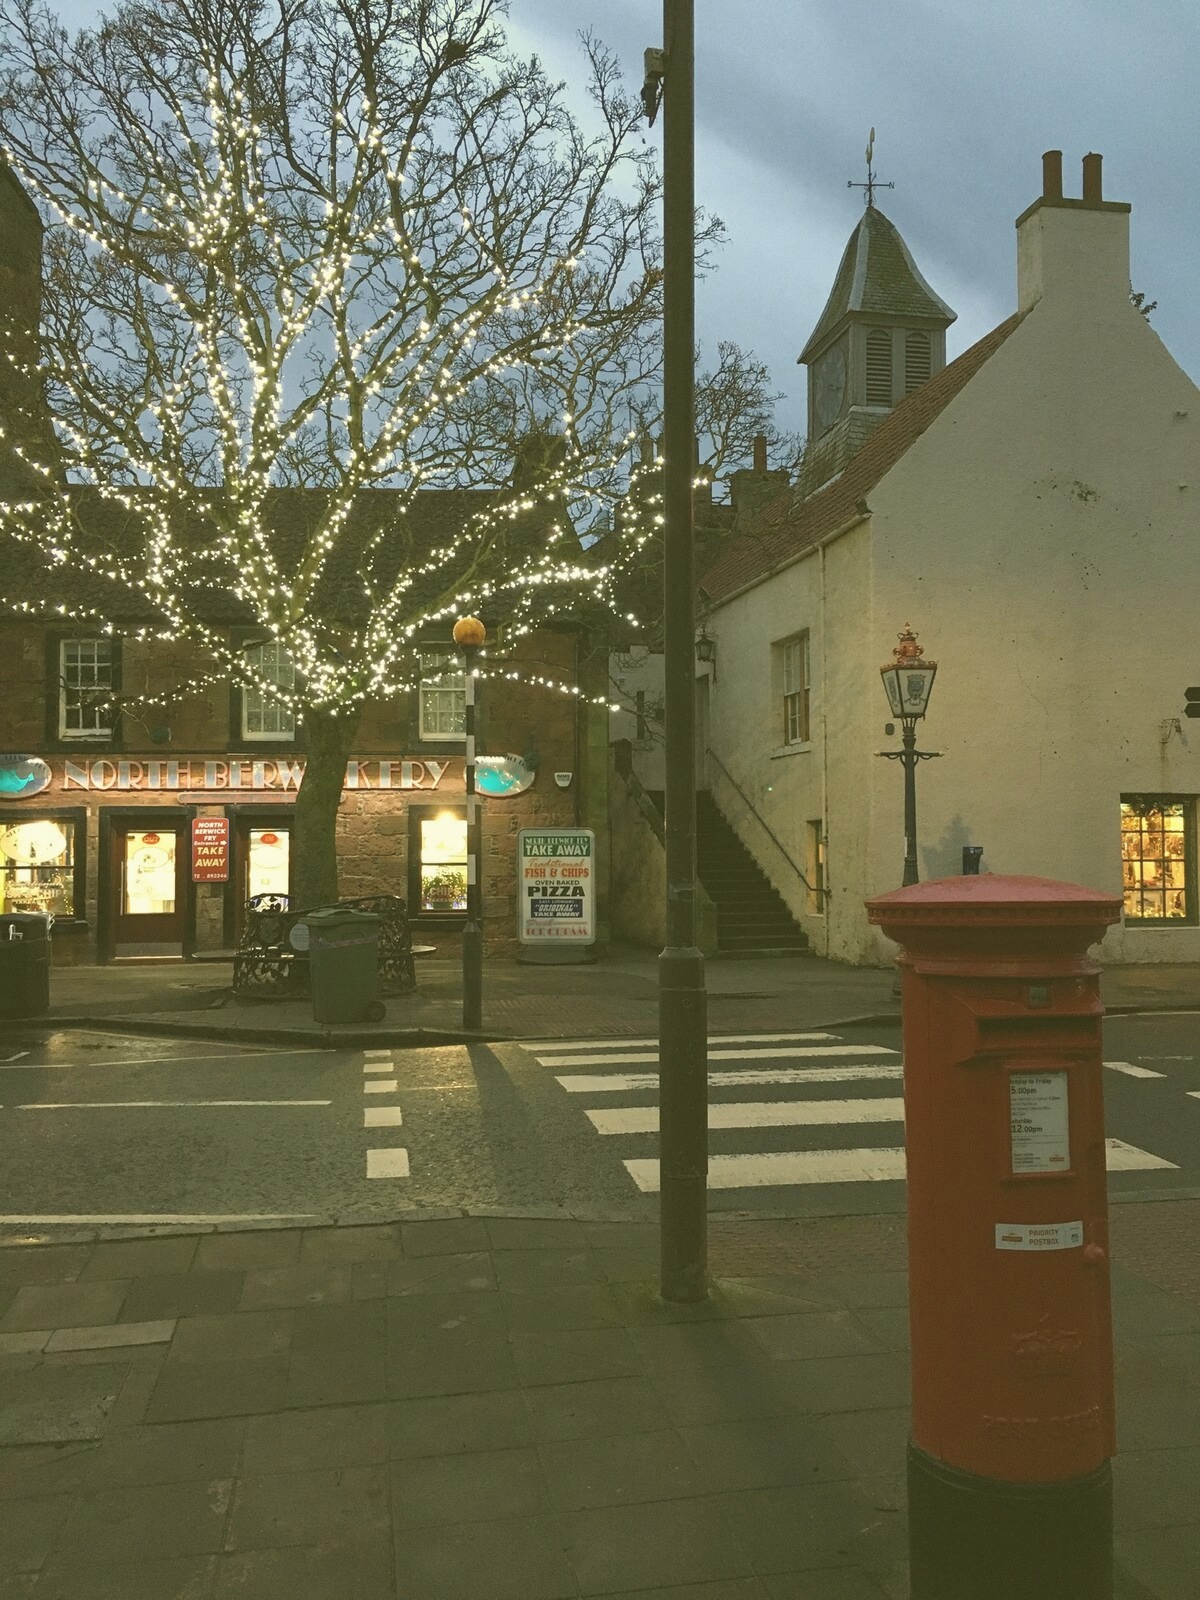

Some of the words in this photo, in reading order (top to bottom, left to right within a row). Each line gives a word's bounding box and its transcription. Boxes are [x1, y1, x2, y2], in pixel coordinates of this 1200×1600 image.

[63, 760, 191, 790] NORTH
[205, 760, 371, 791] BERWK
[379, 760, 450, 790] FRY
[197, 847, 224, 855] TAKE
[526, 846, 553, 855] TAKE
[557, 846, 588, 855] AWAY
[195, 859, 226, 867] AWAY
[528, 858, 586, 868] Traditional
[525, 868, 546, 877] FISH
[550, 868, 557, 877] &
[561, 868, 589, 877] CHIPS
[528, 886, 585, 897] PIZZA
[535, 904, 579, 912] "ORIGINAL"
[1012, 1086, 1037, 1095] 5.00pm
[1012, 1125, 1043, 1133] 12.00pm
